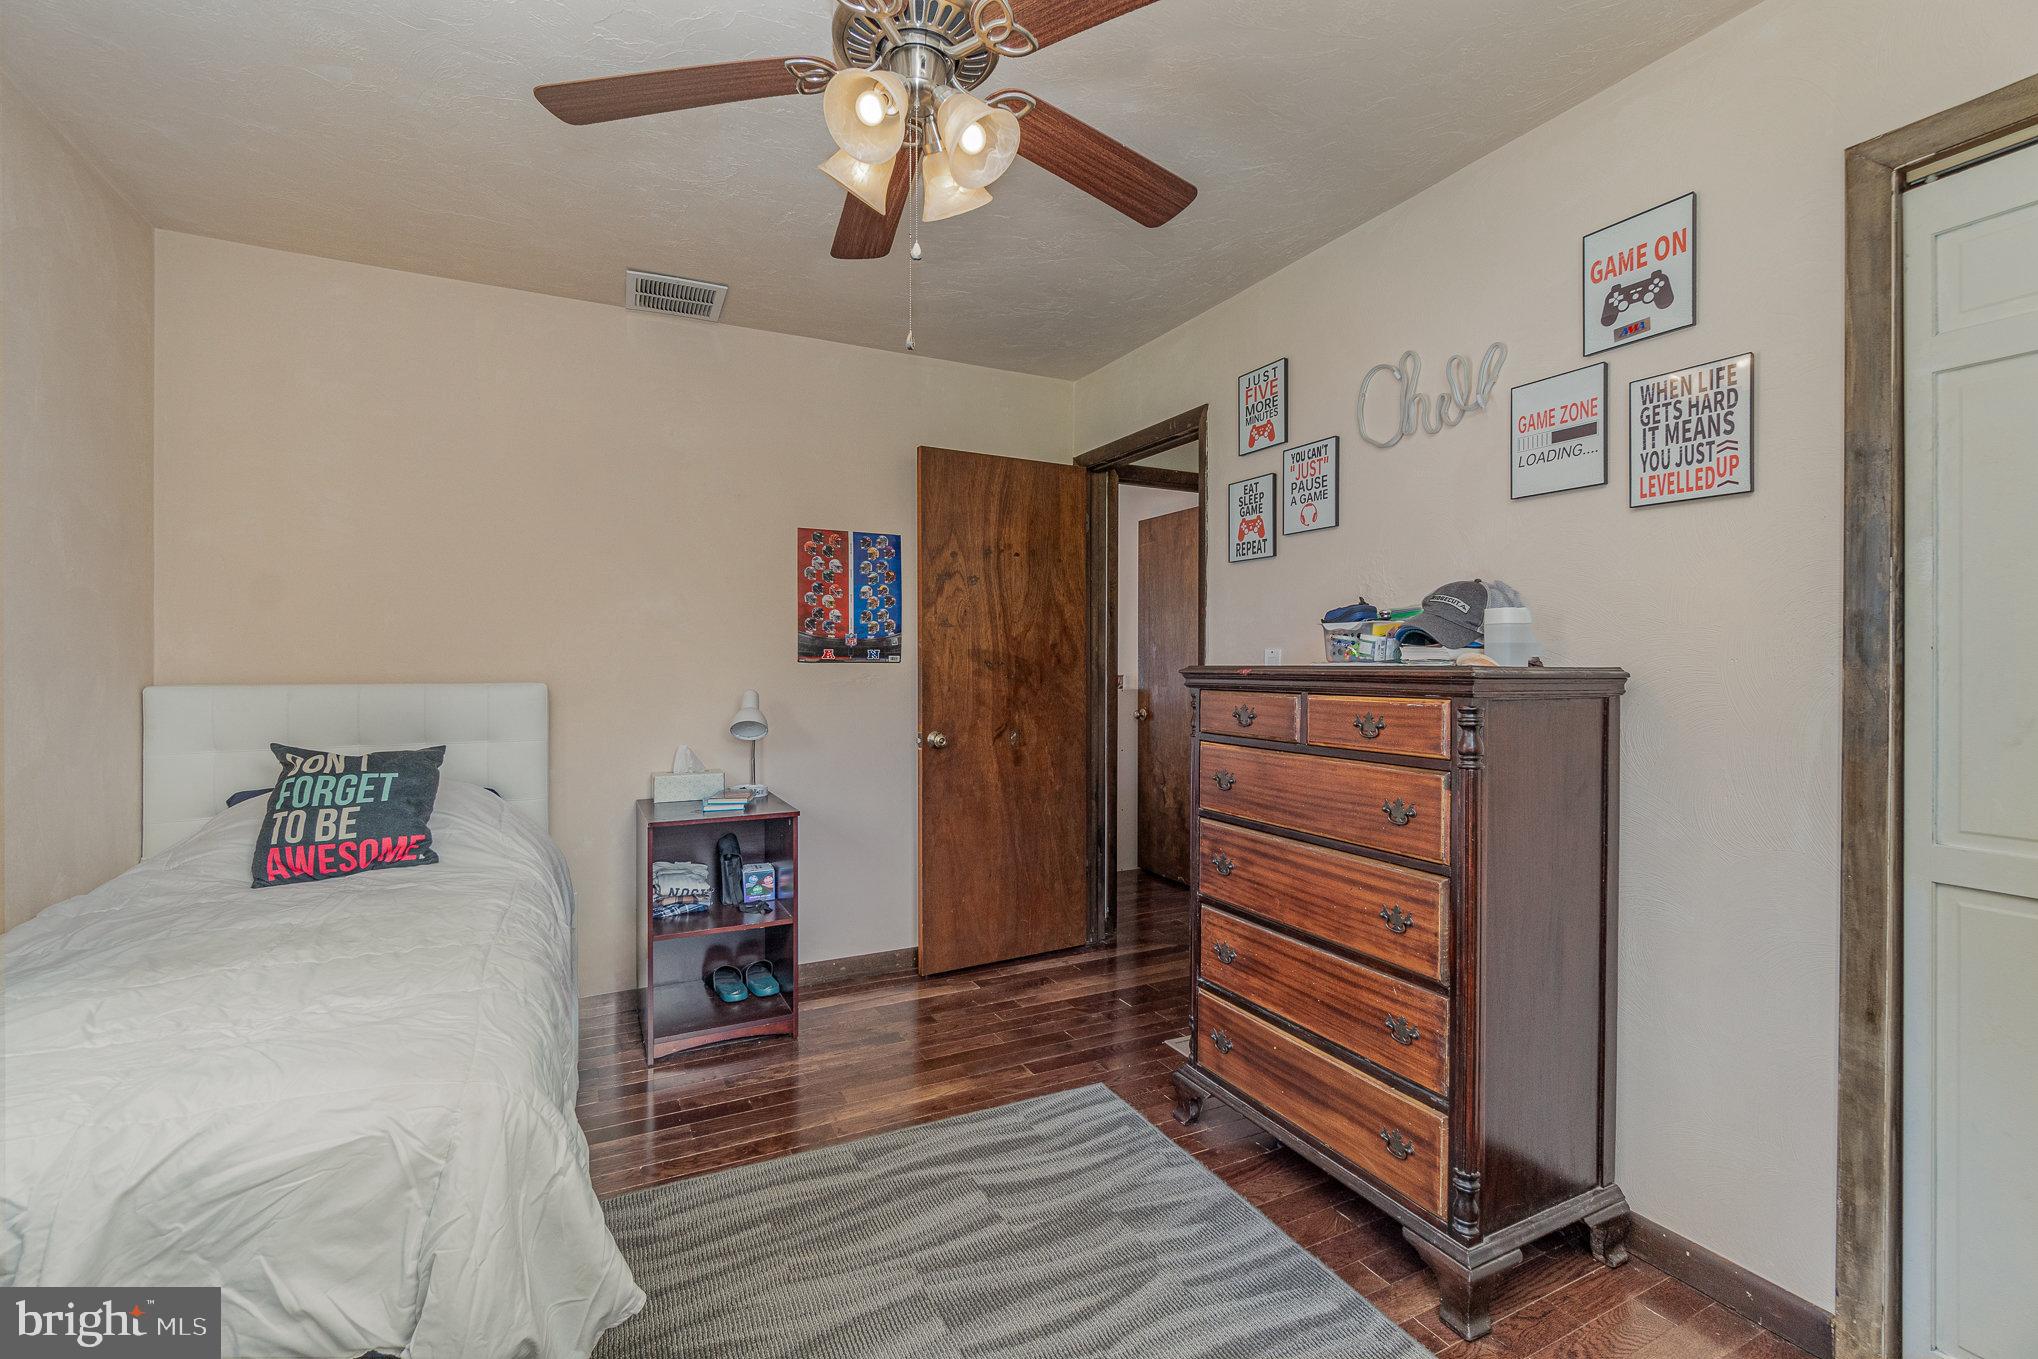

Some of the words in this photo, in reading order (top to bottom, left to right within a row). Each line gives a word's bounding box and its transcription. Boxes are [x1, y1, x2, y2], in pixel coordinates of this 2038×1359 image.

[1590, 242, 1648, 285] GAME
[1654, 227, 1688, 262] ON
[1245, 366, 1279, 390] JUST
[1640, 375, 1692, 406] WHEN
[1698, 363, 1738, 394] LIFE
[1245, 378, 1279, 406] FIVE
[1245, 395, 1279, 418] MORE
[1245, 407, 1279, 427] MINUTES
[1518, 406, 1556, 434] GAME
[1559, 396, 1599, 425] ZONE
[1640, 398, 1683, 428] GETS
[1689, 387, 1739, 412] HARD
[1641, 425, 1660, 451] IT
[1664, 410, 1735, 446] MEANS
[1290, 448, 1306, 465] YOU
[1307, 444, 1329, 460] CAN'T
[1640, 447, 1671, 474] YOU
[1675, 440, 1716, 469] JUST
[1290, 456, 1329, 481] "JUST"
[1639, 464, 1716, 499] LEVELLED
[1716, 454, 1740, 478] UP
[1243, 481, 1259, 496] EAT
[1290, 474, 1328, 495] PAUSE
[1238, 491, 1265, 508] SLEEP
[1239, 502, 1264, 518] GAME
[1290, 495, 1297, 507] A
[1299, 488, 1328, 505] GAME
[1235, 539, 1267, 558] REPEAT
[285, 752, 369, 777] DONT
[275, 772, 399, 810] FORGET
[270, 809, 307, 845] TO
[314, 806, 361, 842] BE
[266, 834, 426, 882] AWESOME
